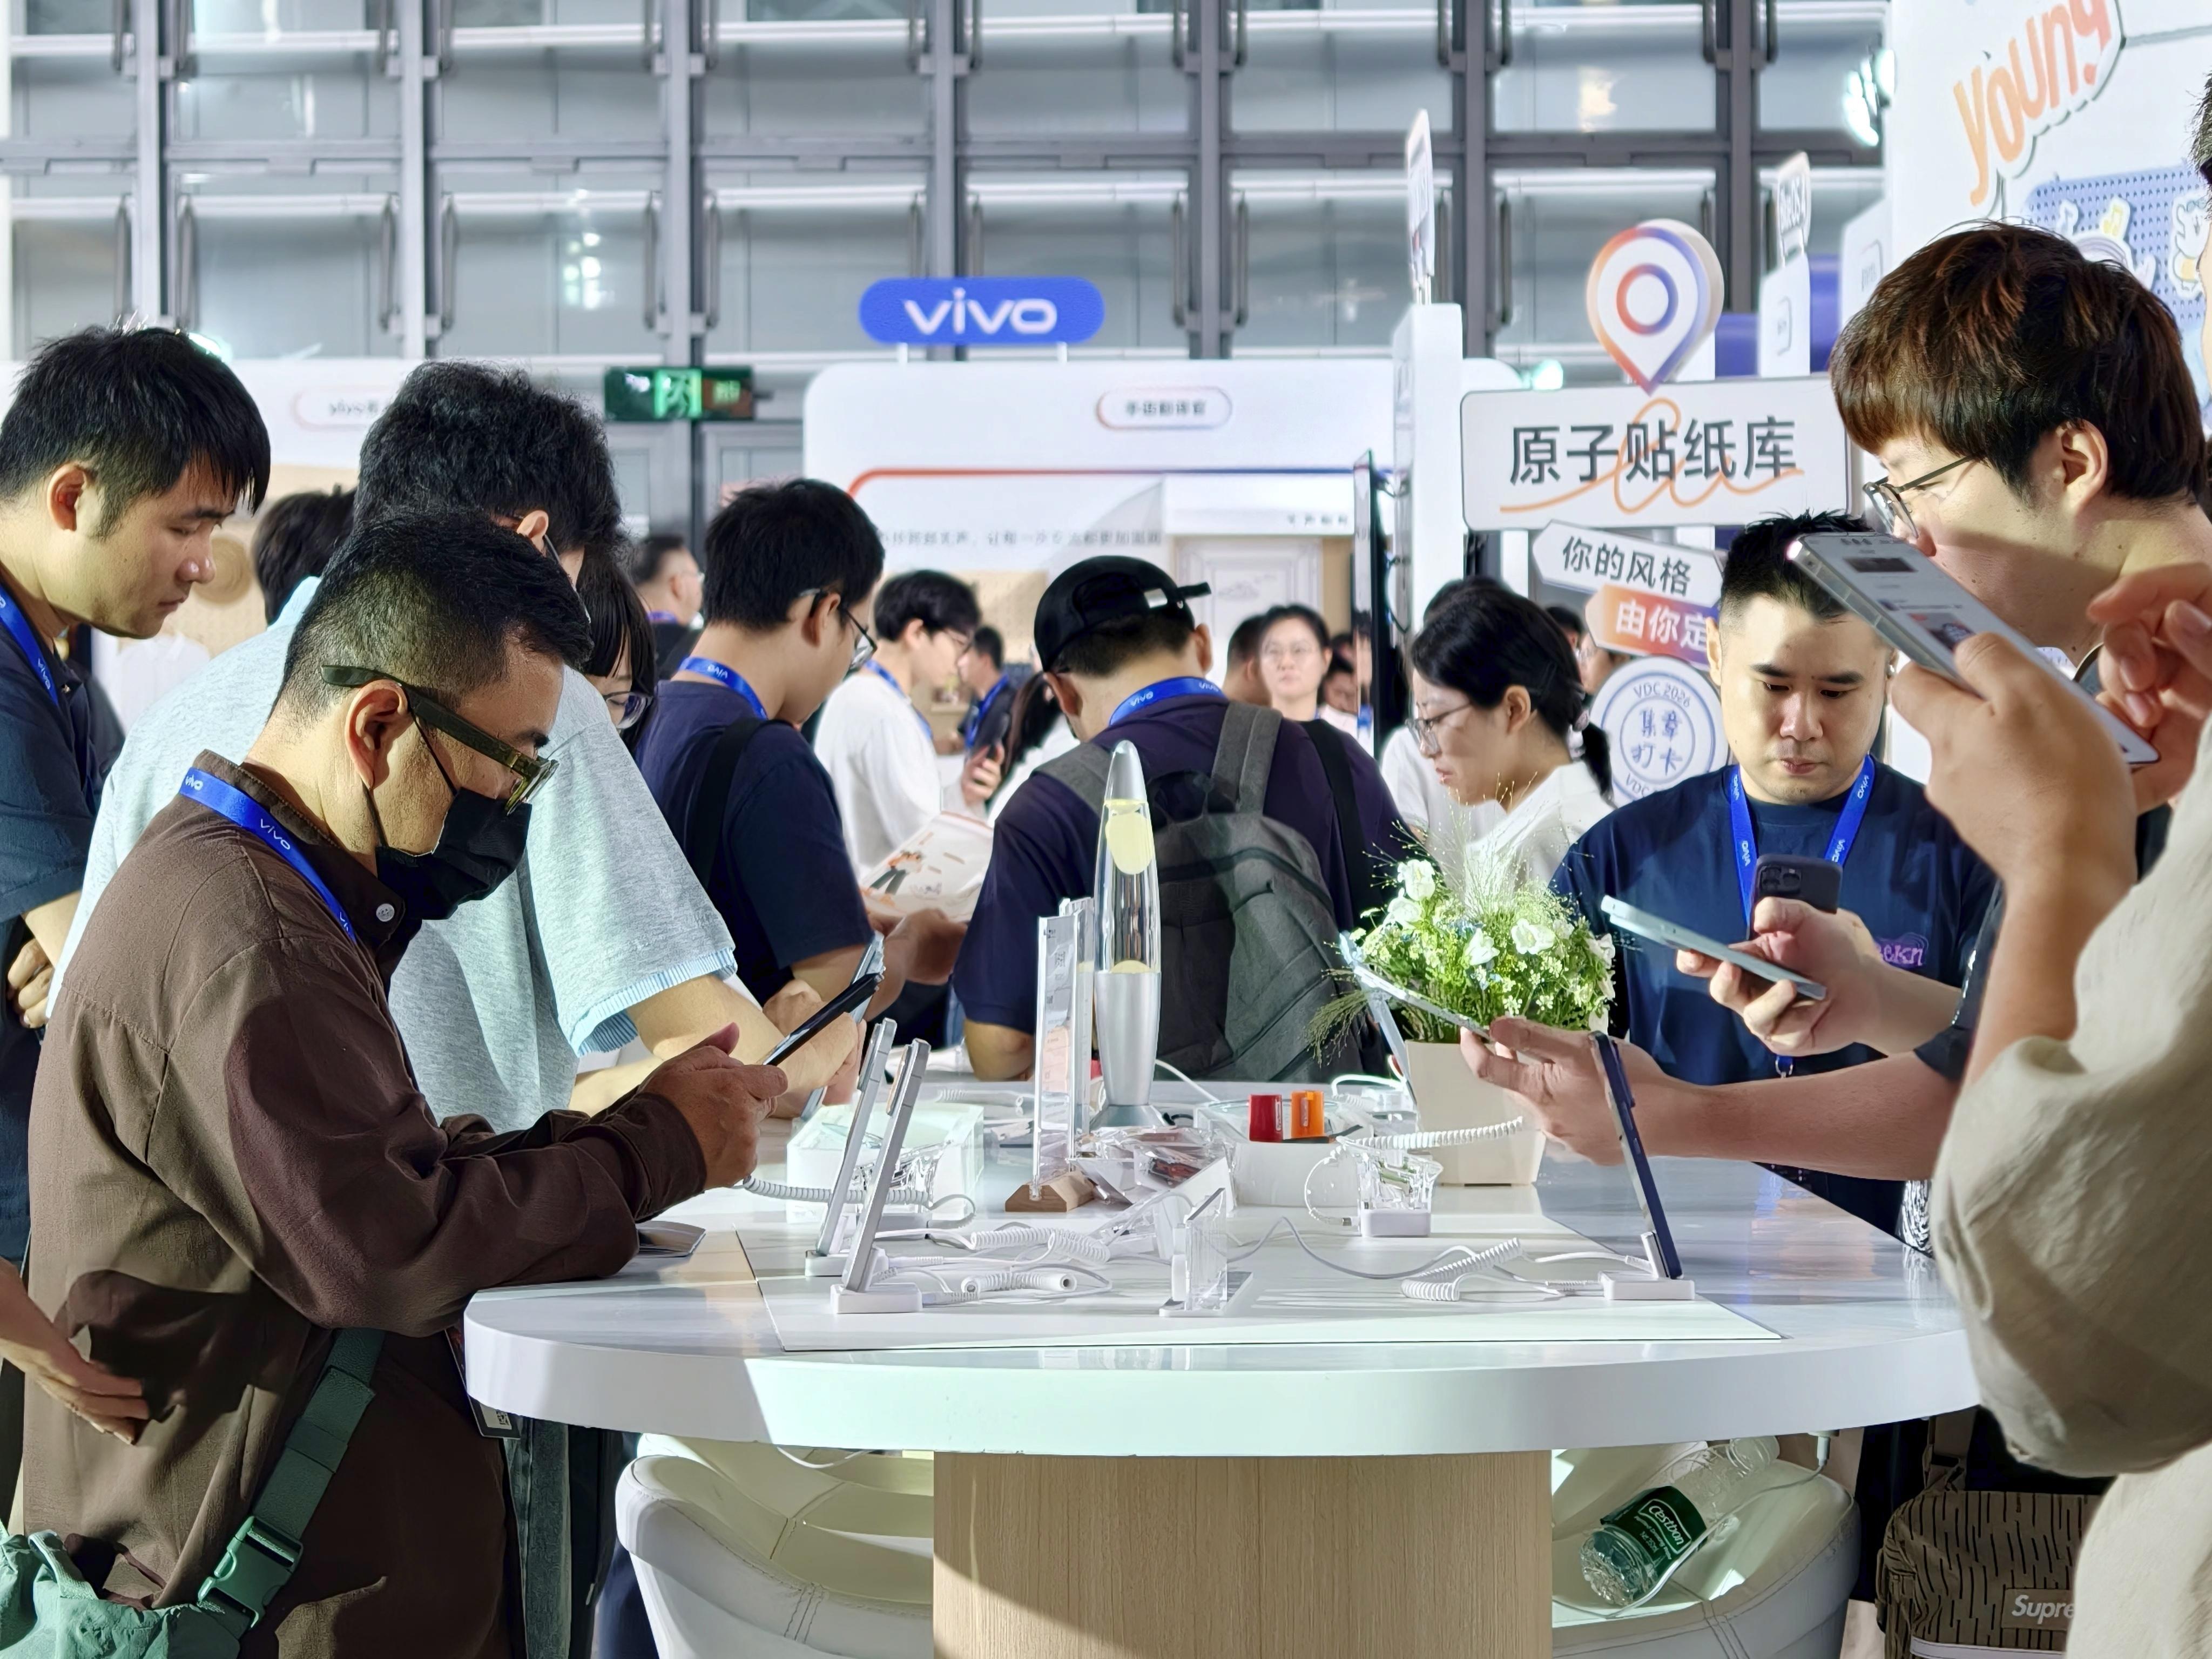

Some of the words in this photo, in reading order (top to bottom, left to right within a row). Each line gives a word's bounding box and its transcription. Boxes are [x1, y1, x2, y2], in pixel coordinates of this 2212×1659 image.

[903, 287, 1058, 335] vivo
[1510, 415, 1797, 485] 原子贴纸库
[1562, 536, 1691, 597] 你的风格
[1615, 599, 1707, 652] 由你定
[1129, 691, 1154, 706] vivo
[1633, 682, 1660, 698] VDC
[260, 818, 291, 850] vivo
